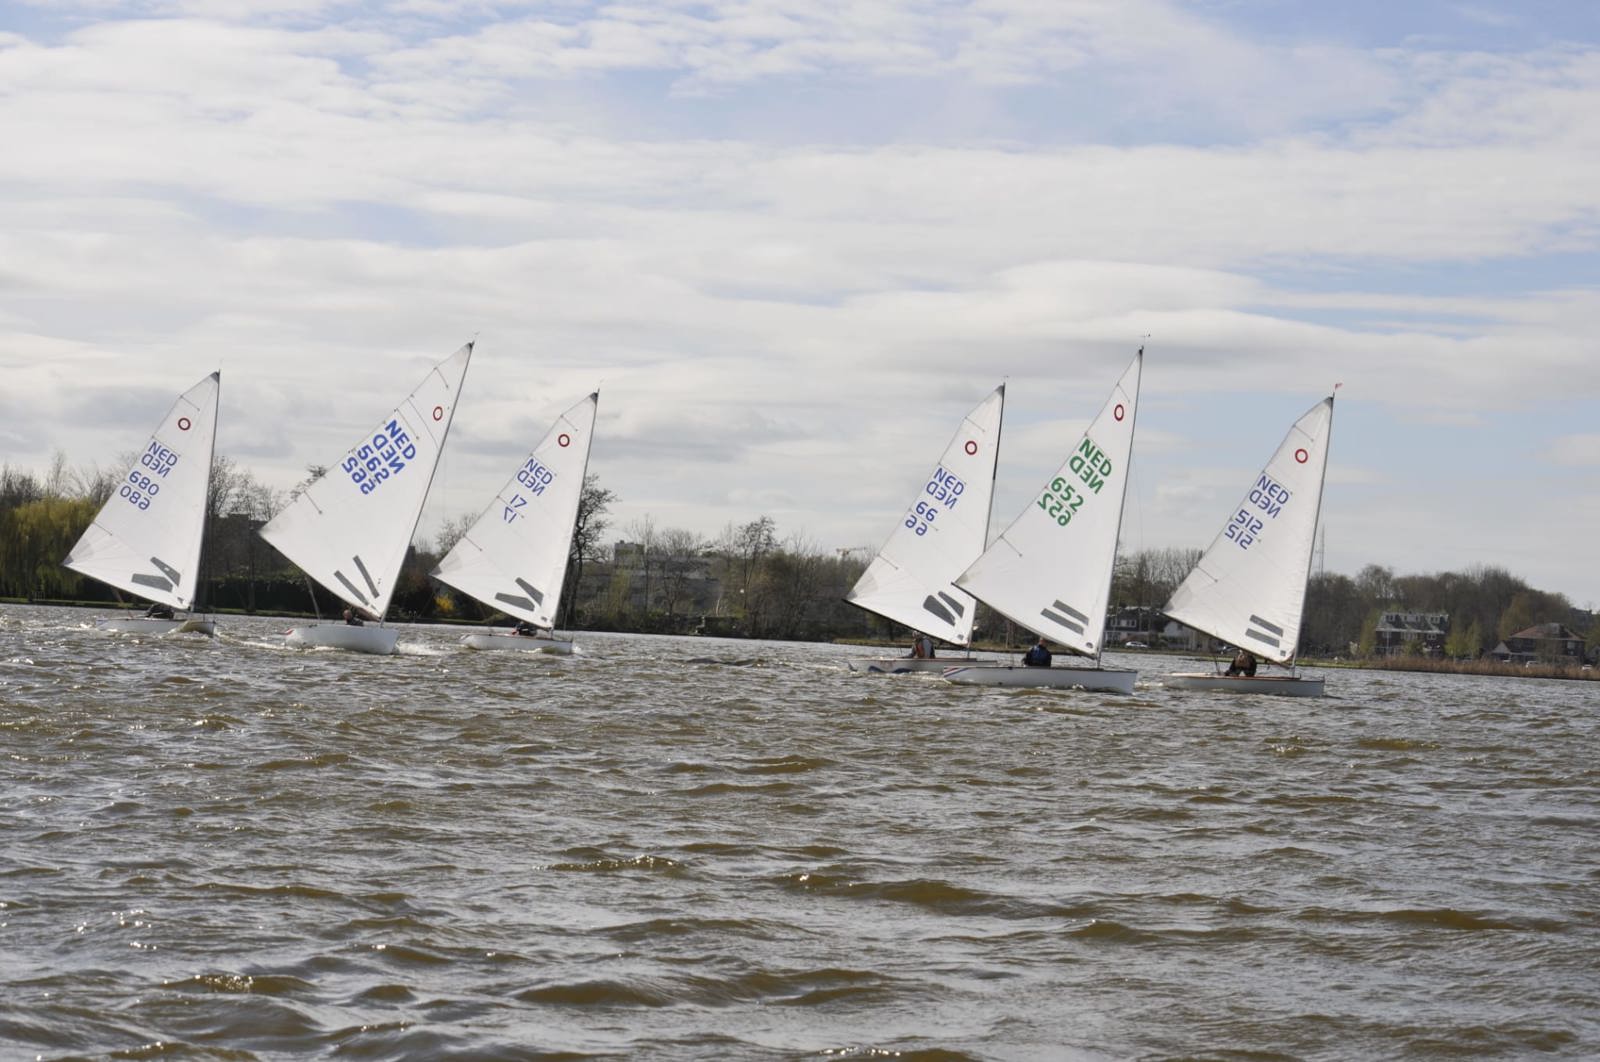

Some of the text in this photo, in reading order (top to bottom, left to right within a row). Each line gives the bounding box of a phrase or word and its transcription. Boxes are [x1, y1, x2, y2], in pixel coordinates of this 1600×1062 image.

[385, 419, 416, 460] NED
[148, 441, 178, 467] NED
[357, 444, 390, 484] 562
[1079, 438, 1112, 477] NED
[129, 471, 159, 496] 680
[525, 458, 553, 485] NED
[934, 467, 964, 496] NED
[510, 494, 527, 508] 17
[1051, 477, 1084, 512] 652
[1257, 475, 1289, 505] NED
[915, 501, 938, 522] 66
[1235, 509, 1263, 535] 512
